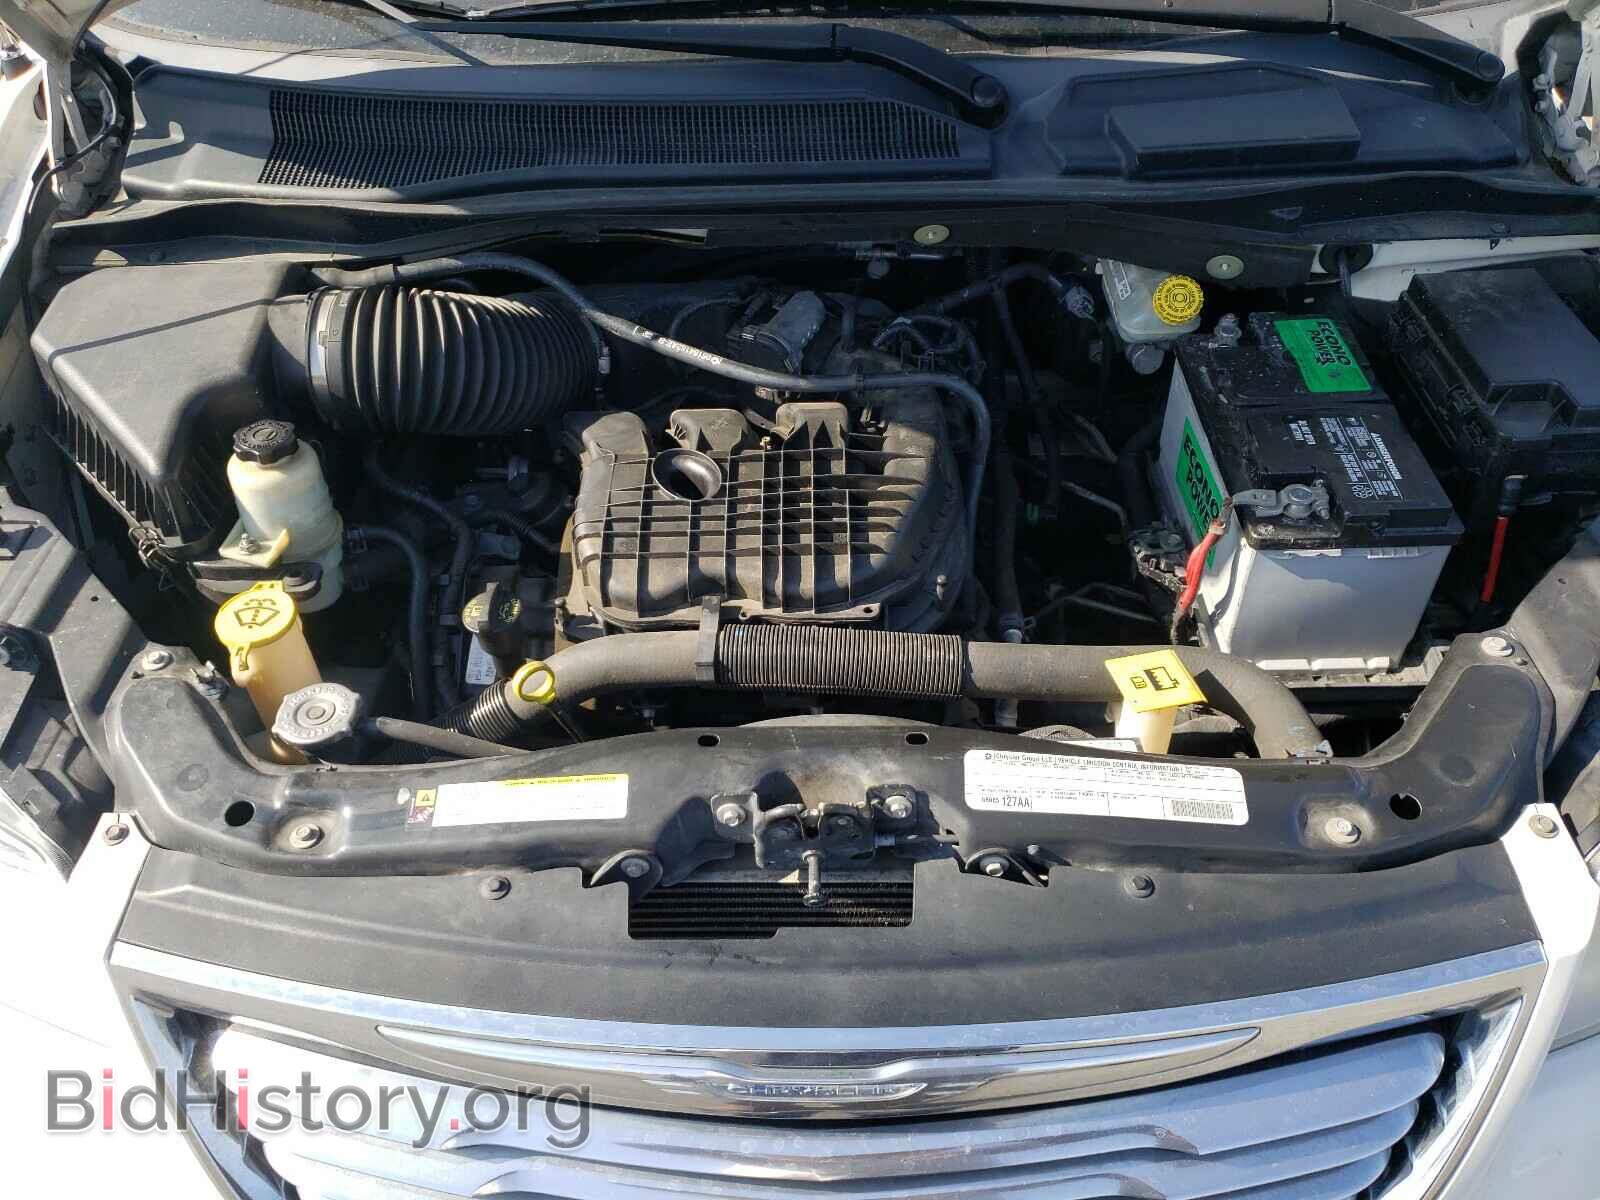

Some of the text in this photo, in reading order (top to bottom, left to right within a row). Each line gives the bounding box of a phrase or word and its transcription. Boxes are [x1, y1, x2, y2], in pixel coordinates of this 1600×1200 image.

[1307, 329, 1337, 365] POWER
[1318, 321, 1351, 366] ECONO
[1001, 796, 1030, 808] 127AA
